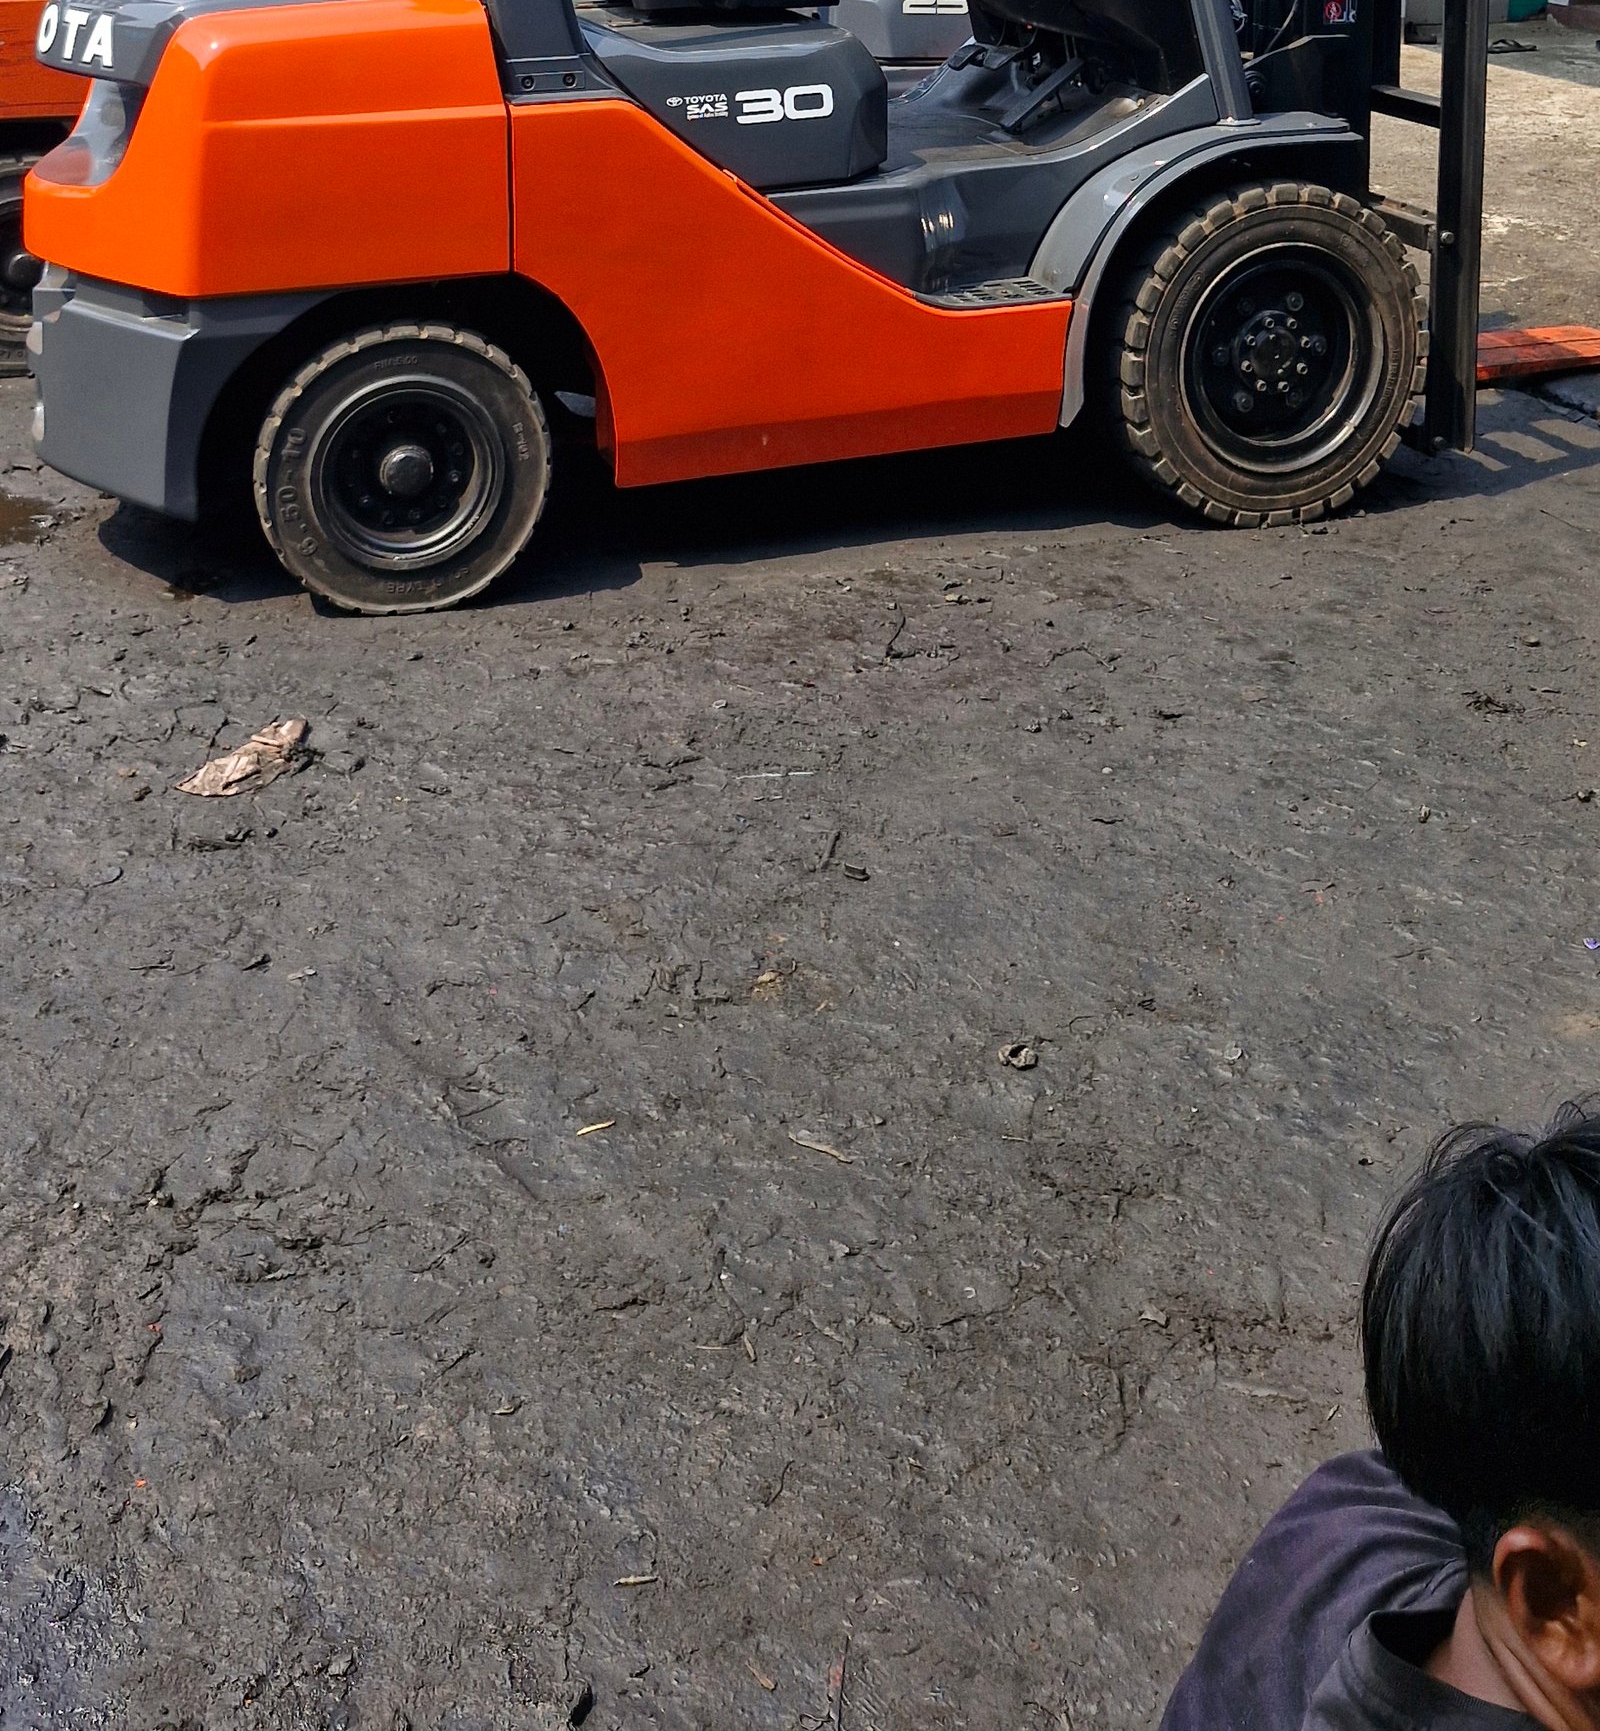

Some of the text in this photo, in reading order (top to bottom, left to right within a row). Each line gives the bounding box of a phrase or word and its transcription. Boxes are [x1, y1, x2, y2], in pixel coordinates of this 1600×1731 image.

[684, 93, 728, 105] TOYOTA
[735, 83, 834, 125] 30
[686, 101, 729, 115] SAS
